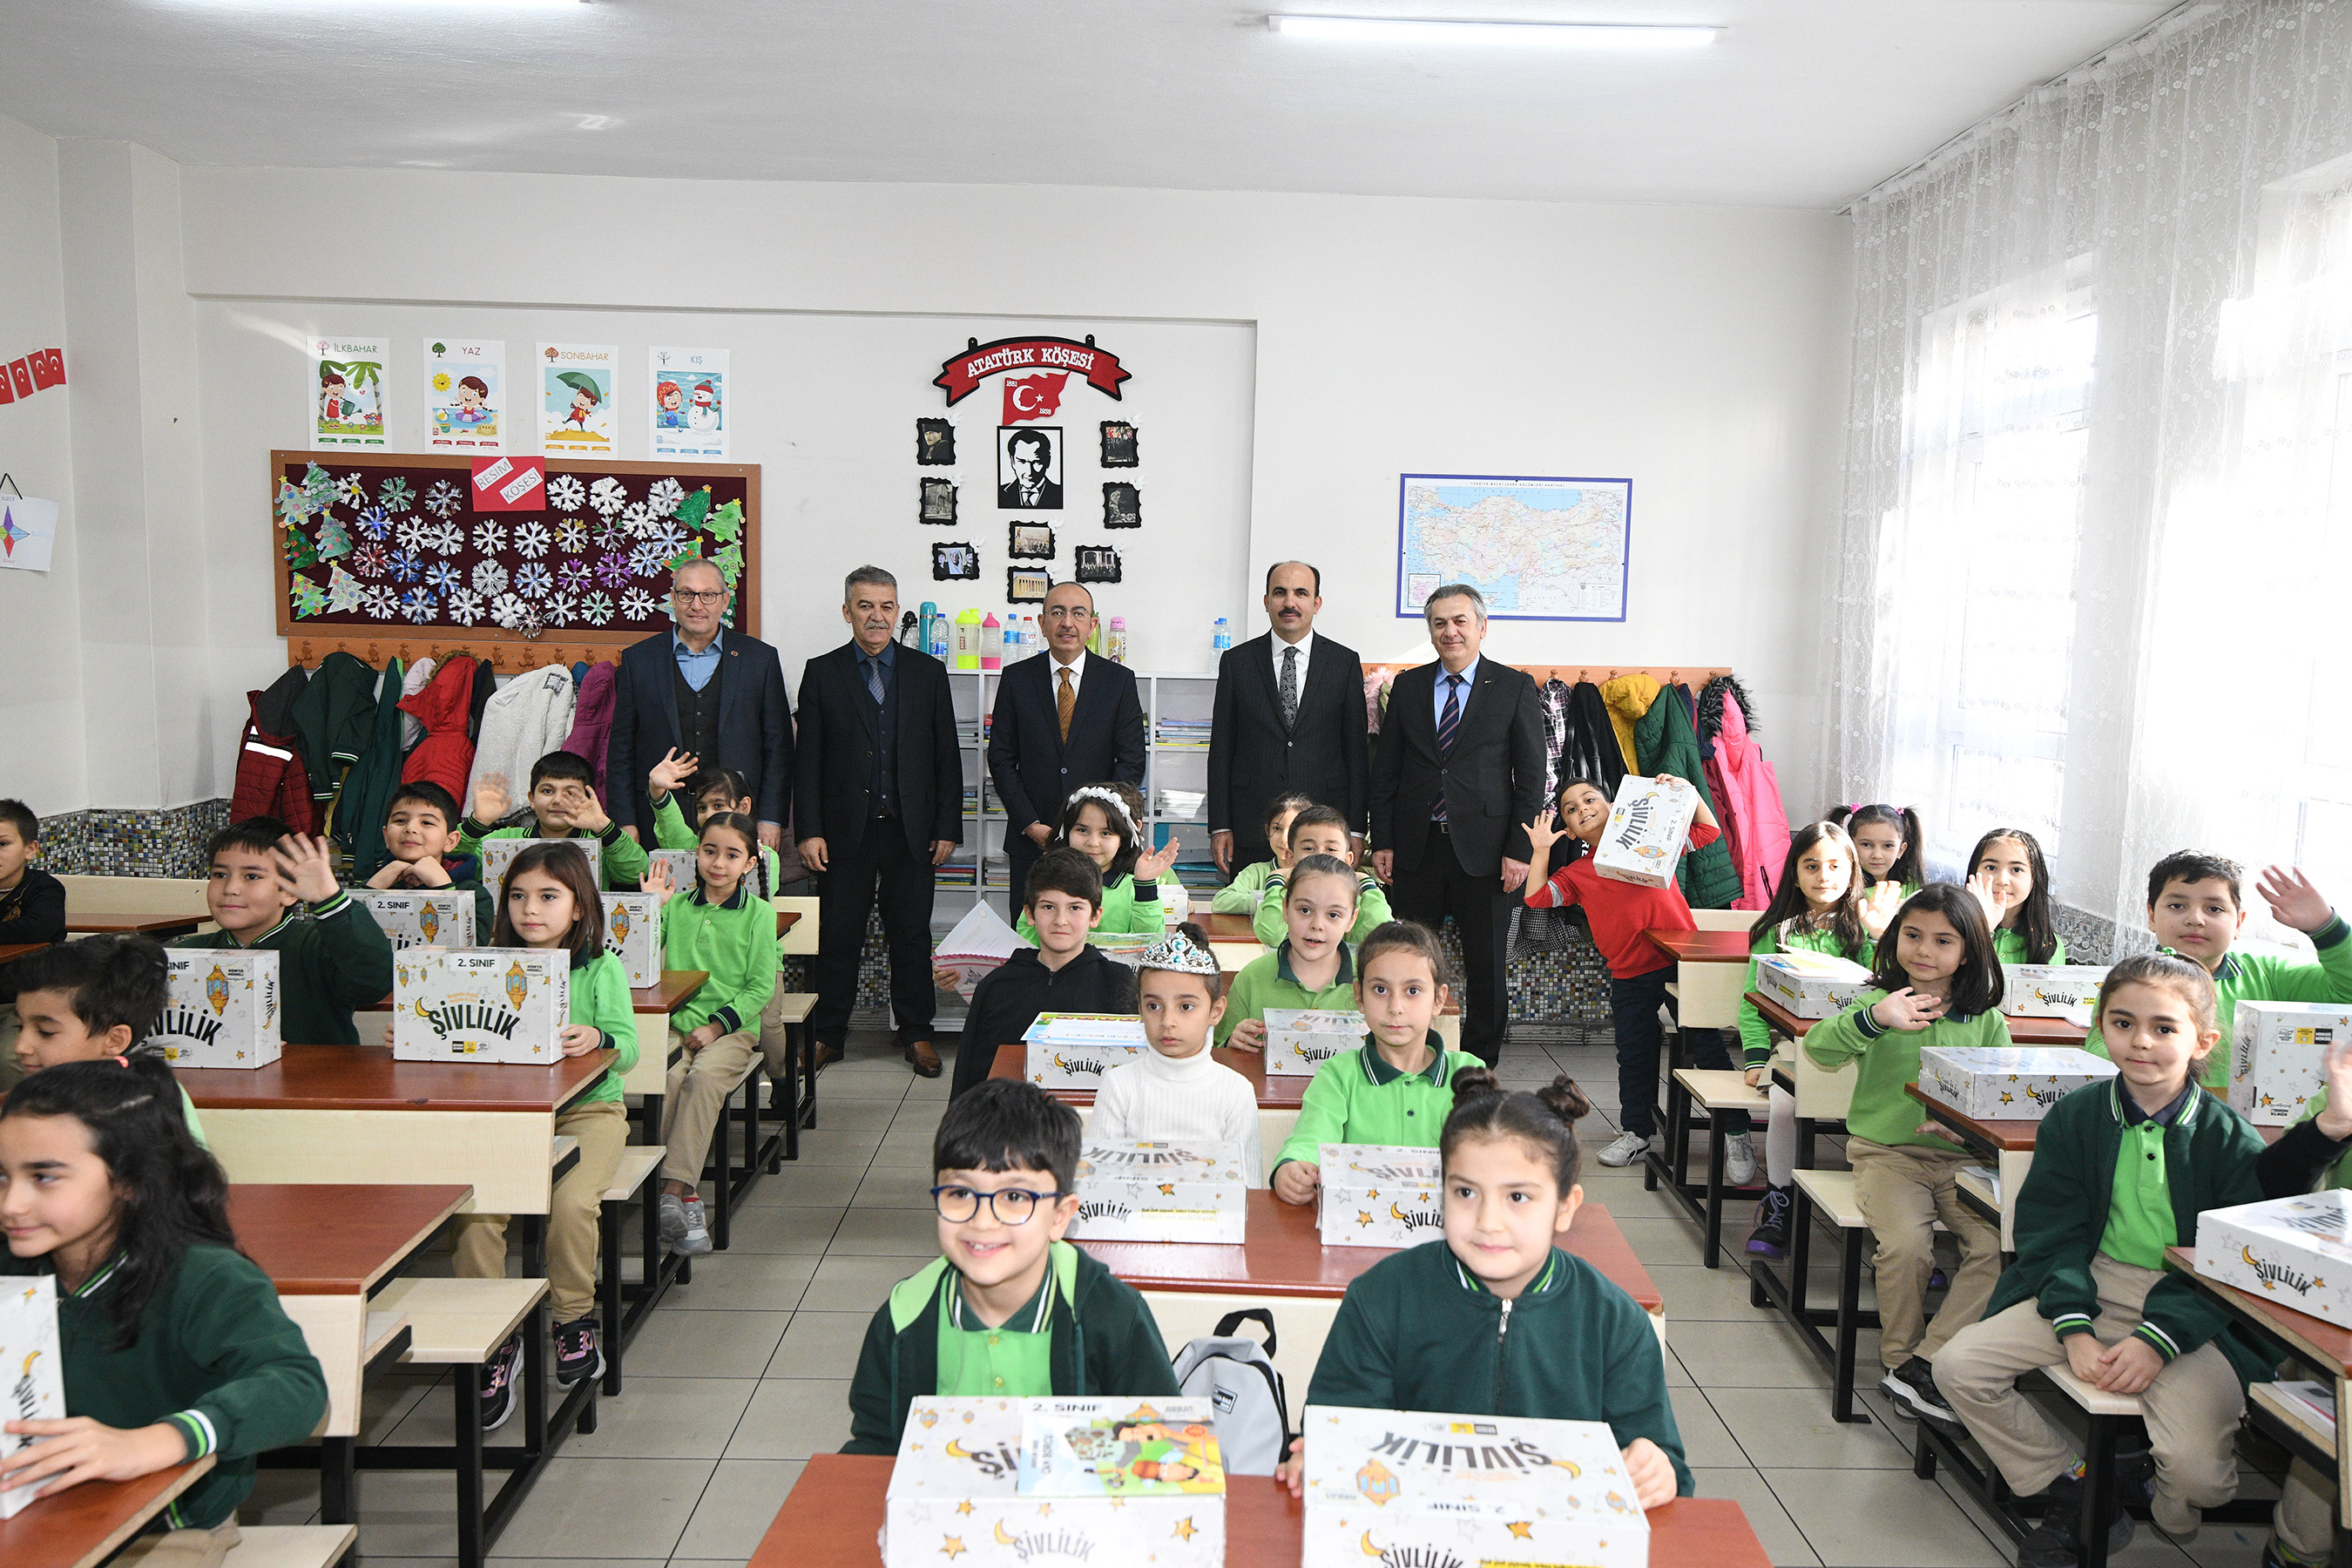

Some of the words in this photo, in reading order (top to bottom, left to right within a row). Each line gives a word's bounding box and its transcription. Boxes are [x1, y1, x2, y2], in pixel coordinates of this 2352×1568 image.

[334, 342, 377, 354] İLKBAHAR
[461, 347, 481, 356] YAZ
[560, 351, 609, 362] SONBAHAR
[690, 355, 703, 365] KIŞ
[967, 348, 1035, 378] ATATÜRK
[1041, 346, 1095, 371] KÖŞESİ
[1616, 798, 1654, 850] ŞİVLİLİK
[377, 901, 385, 909] 2.
[457, 958, 466, 967] 2.
[470, 958, 496, 968] SINIF
[2043, 991, 2078, 1007] ŞİVLİLİK
[429, 998, 521, 1041] ŞİVLİLİK
[1064, 1058, 1105, 1077] ŞİVLİLİK
[1078, 1200, 1132, 1223] ŞİVLİLİK
[2254, 1259, 2312, 1297] ŞİVLİLİK
[1054, 1402, 1103, 1412] SINIF
[1369, 1431, 1552, 1475] ŞİVLİLİK
[1013, 1528, 1095, 1564] ŞİVLİLİK
